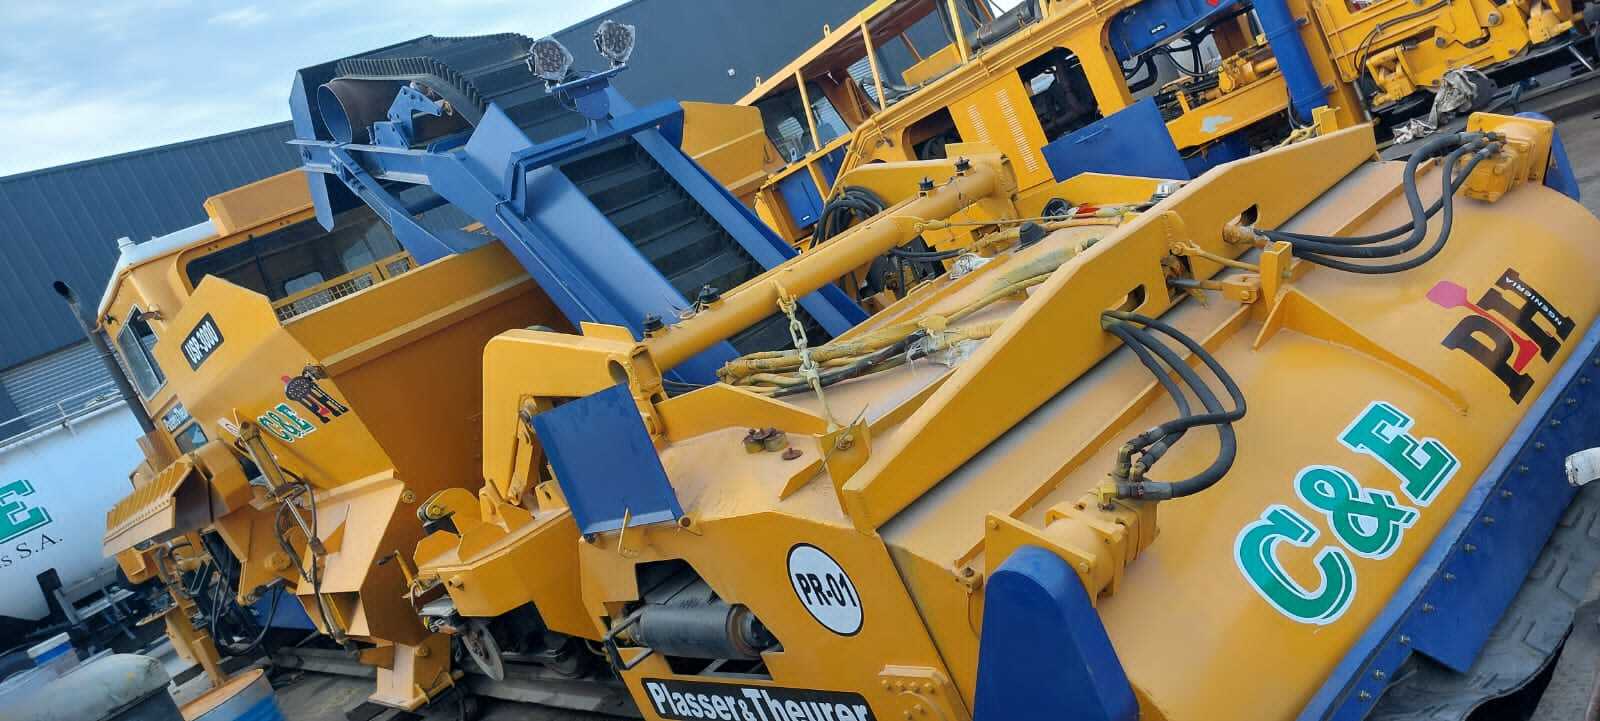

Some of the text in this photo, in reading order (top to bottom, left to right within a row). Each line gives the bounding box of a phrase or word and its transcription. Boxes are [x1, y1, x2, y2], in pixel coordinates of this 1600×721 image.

[184, 320, 219, 364] USP-3000
[257, 402, 316, 442] C&E
[1235, 401, 1460, 624] C&E
[16, 533, 63, 559] S.A.
[795, 572, 857, 607] PR-01
